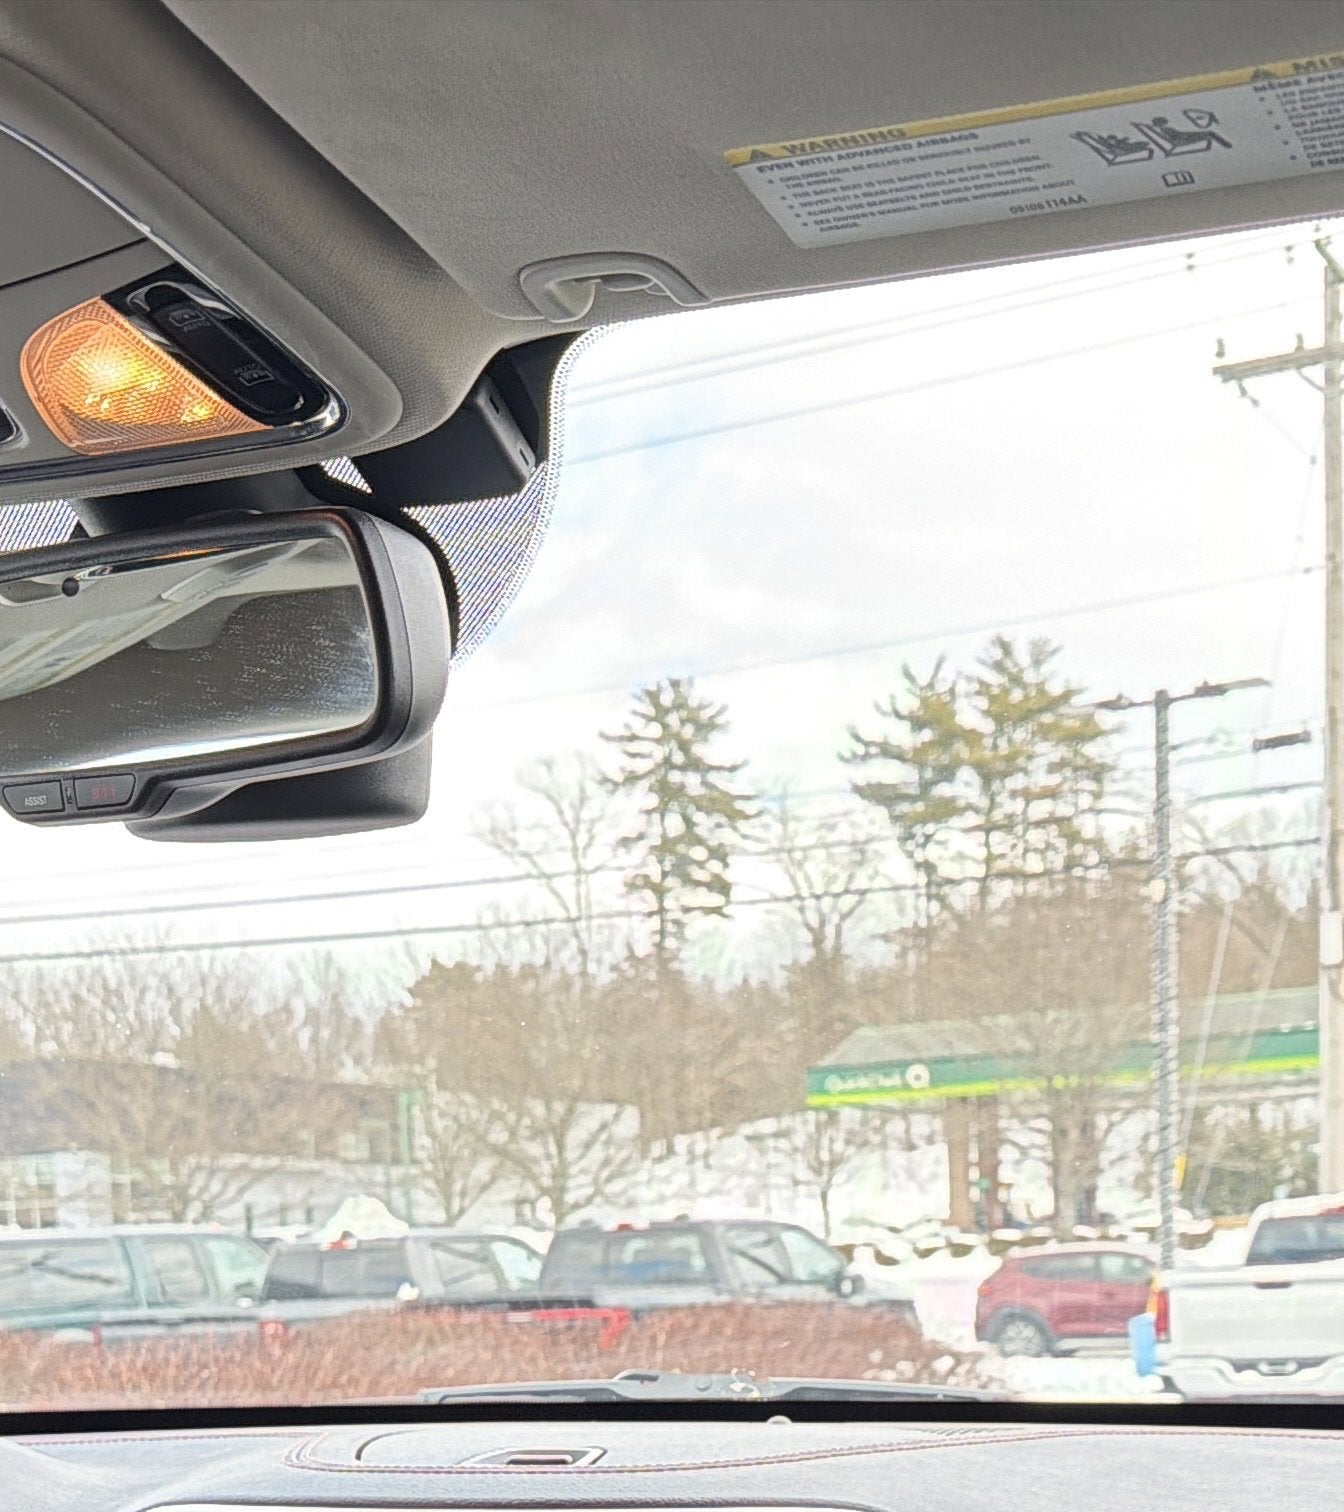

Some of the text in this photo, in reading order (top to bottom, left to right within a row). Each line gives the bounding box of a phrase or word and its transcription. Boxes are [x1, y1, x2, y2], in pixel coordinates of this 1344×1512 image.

[757, 160, 794, 173] EVEN
[796, 154, 833, 167] WITH
[916, 131, 978, 148] AIRBAGS
[781, 126, 906, 156] WARNING
